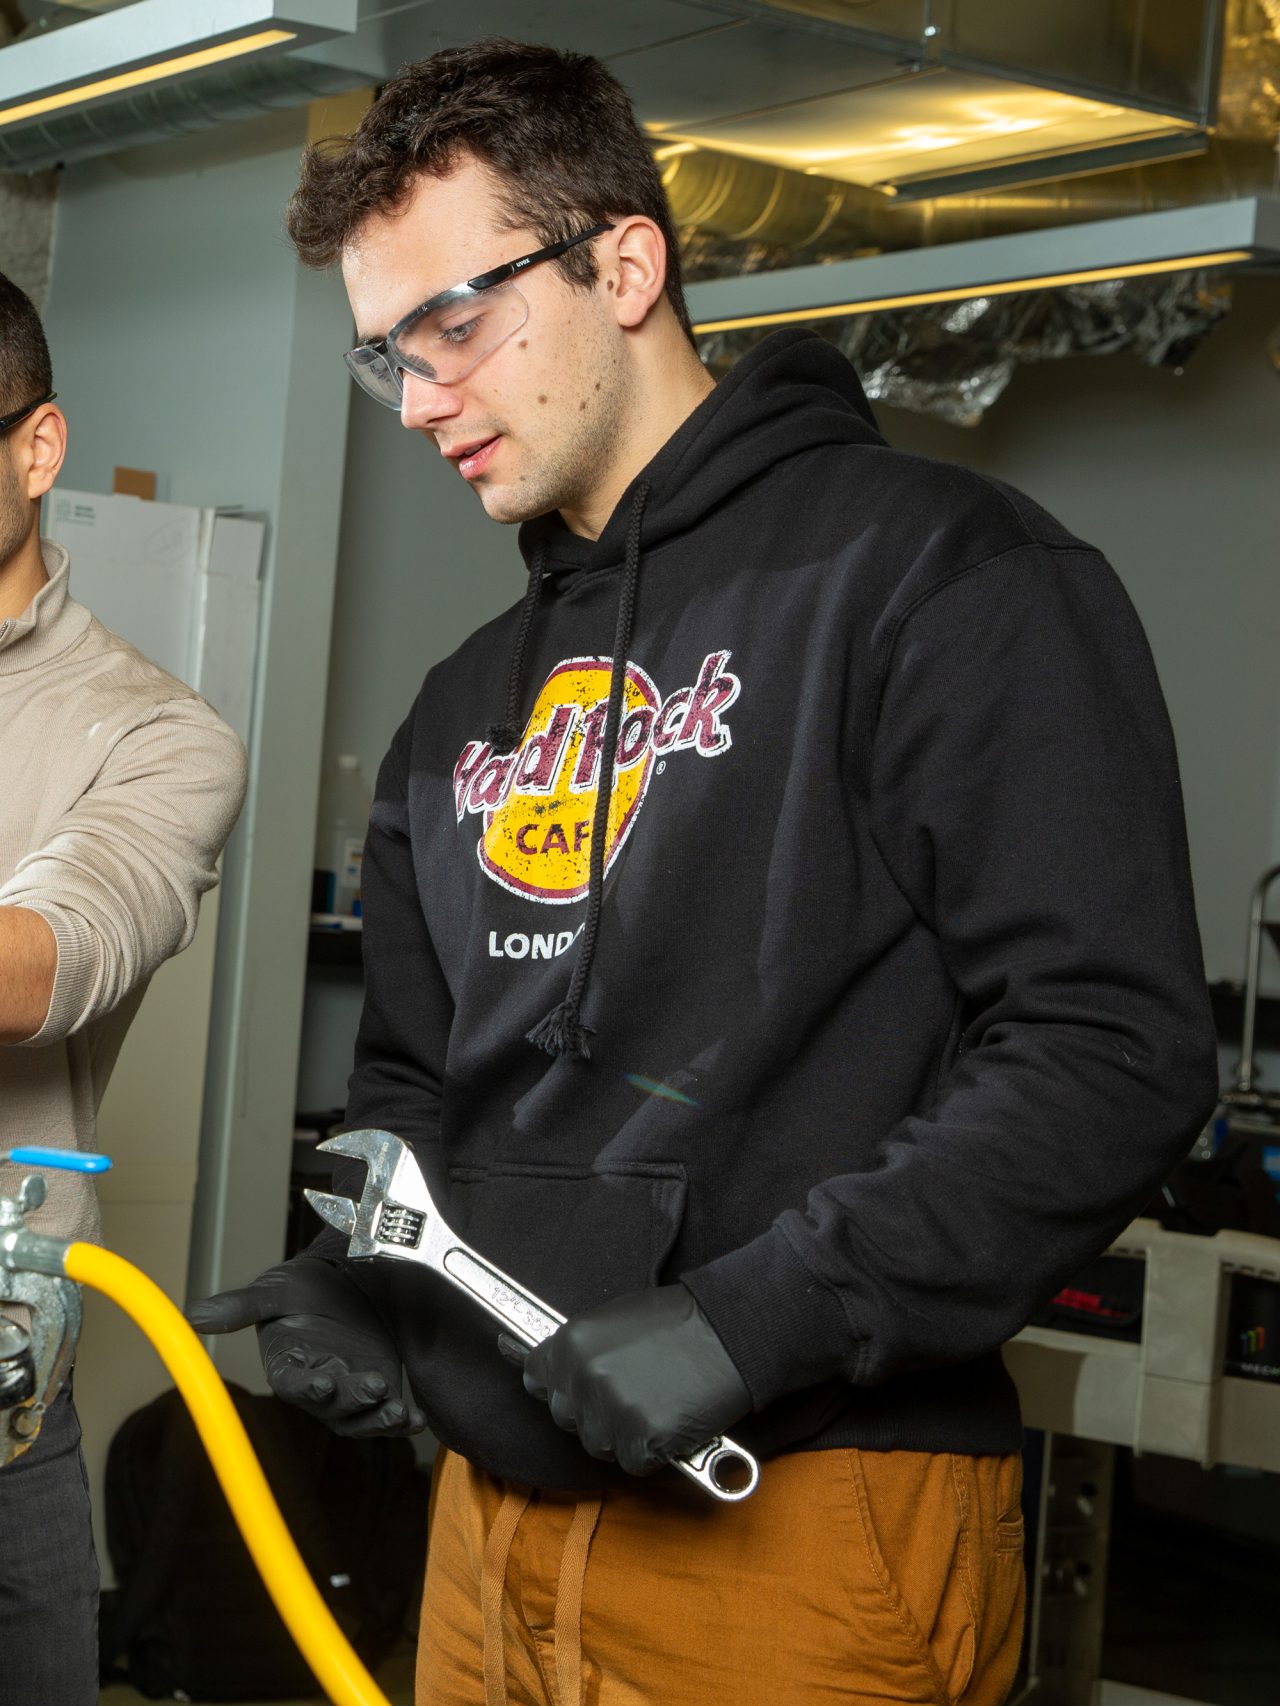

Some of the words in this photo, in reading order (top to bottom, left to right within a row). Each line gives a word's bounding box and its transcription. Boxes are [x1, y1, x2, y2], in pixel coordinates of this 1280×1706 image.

[453, 704, 582, 823] Had
[516, 820, 590, 855] CAF
[489, 923, 584, 960] LOND
